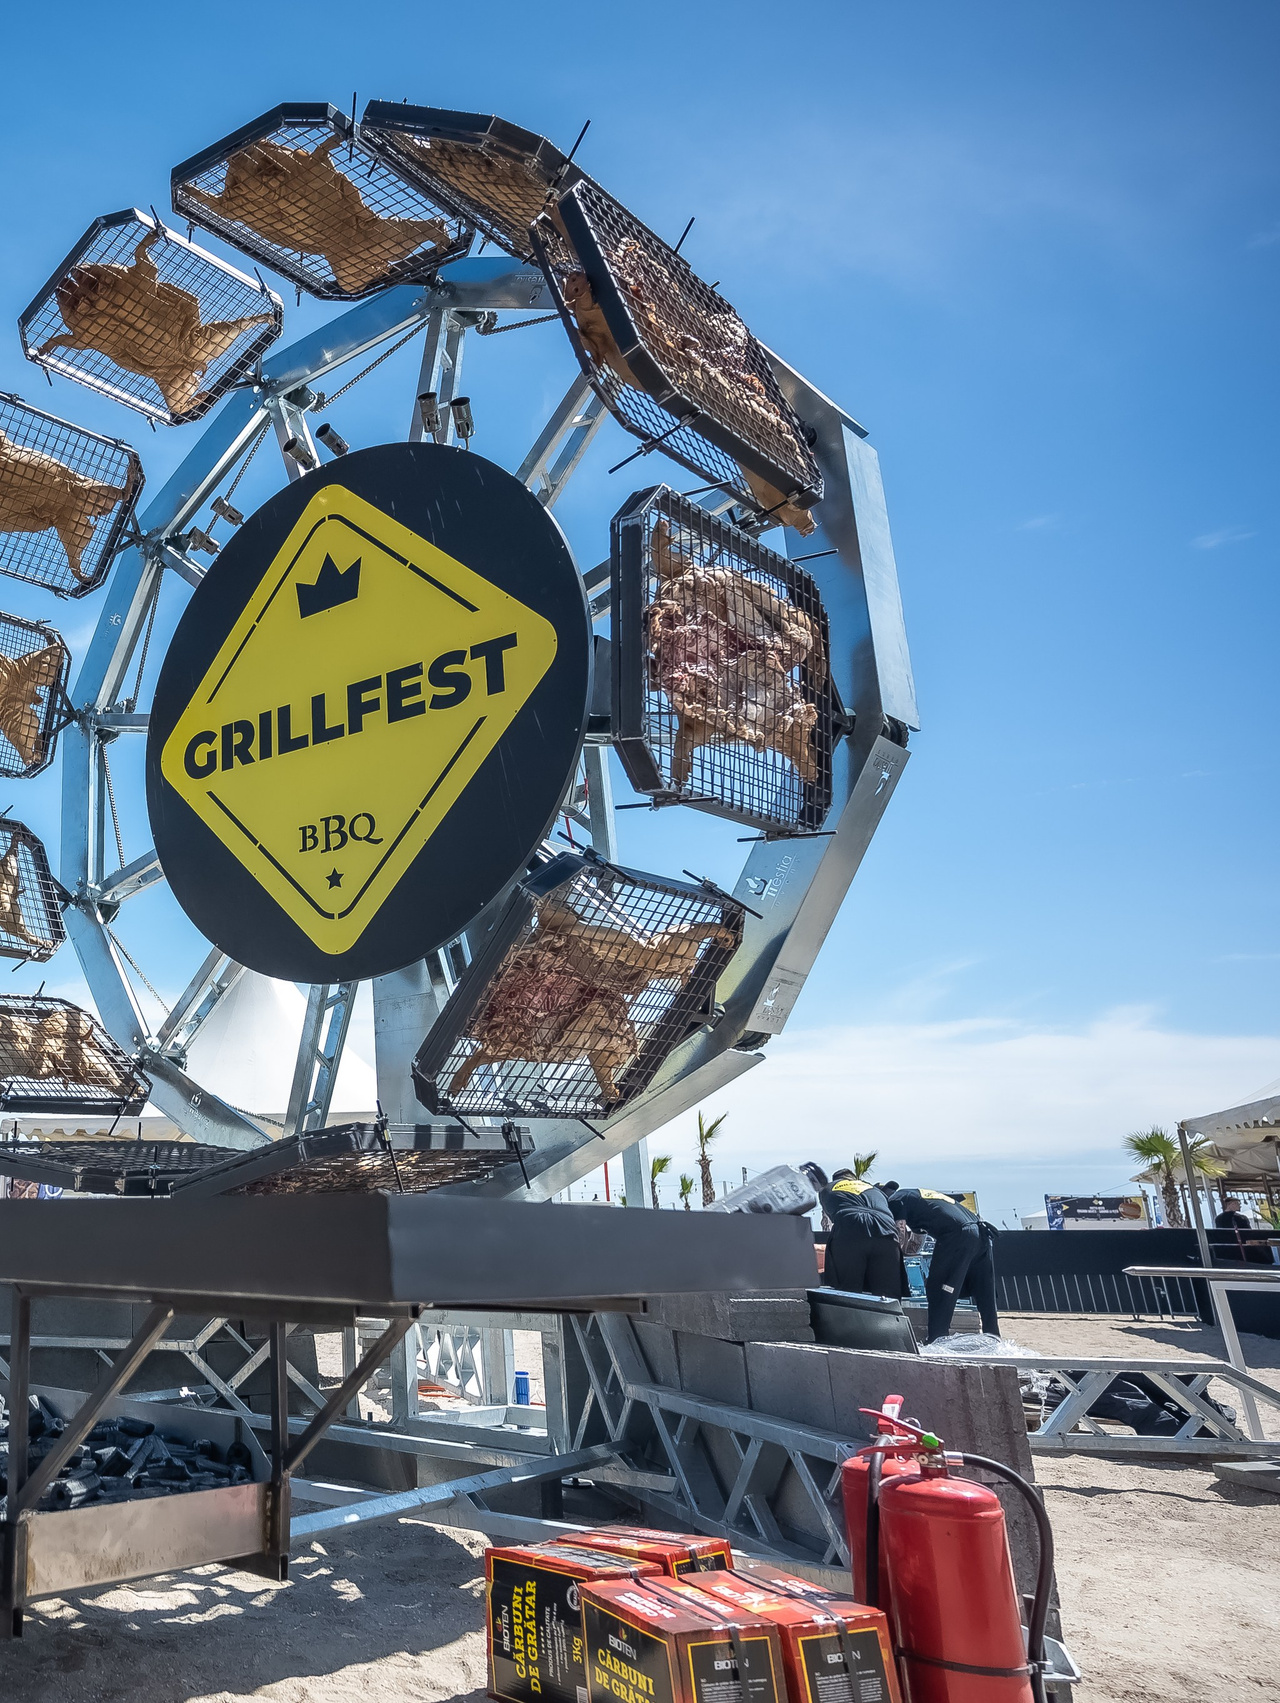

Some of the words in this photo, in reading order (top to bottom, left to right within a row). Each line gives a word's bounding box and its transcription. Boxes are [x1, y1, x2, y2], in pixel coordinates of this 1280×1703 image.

[183, 631, 518, 780] GRILLFEST
[298, 811, 383, 855] BBQ
[767, 855, 793, 897] Hestia
[501, 1604, 510, 1652] BIOTEN
[512, 1585, 527, 1679] CĂRBUNI
[524, 1580, 538, 1662] GRĂTAR
[572, 1636, 583, 1664] 3Kg
[608, 1634, 637, 1661] BIOTEN
[714, 1658, 749, 1670] BIOTN
[827, 1650, 861, 1664] BION
[529, 1664, 542, 1694] DE
[595, 1666, 610, 1690] DE
[611, 1678, 654, 1703] GRĂT
[598, 1648, 655, 1696] CĂRBUNI
